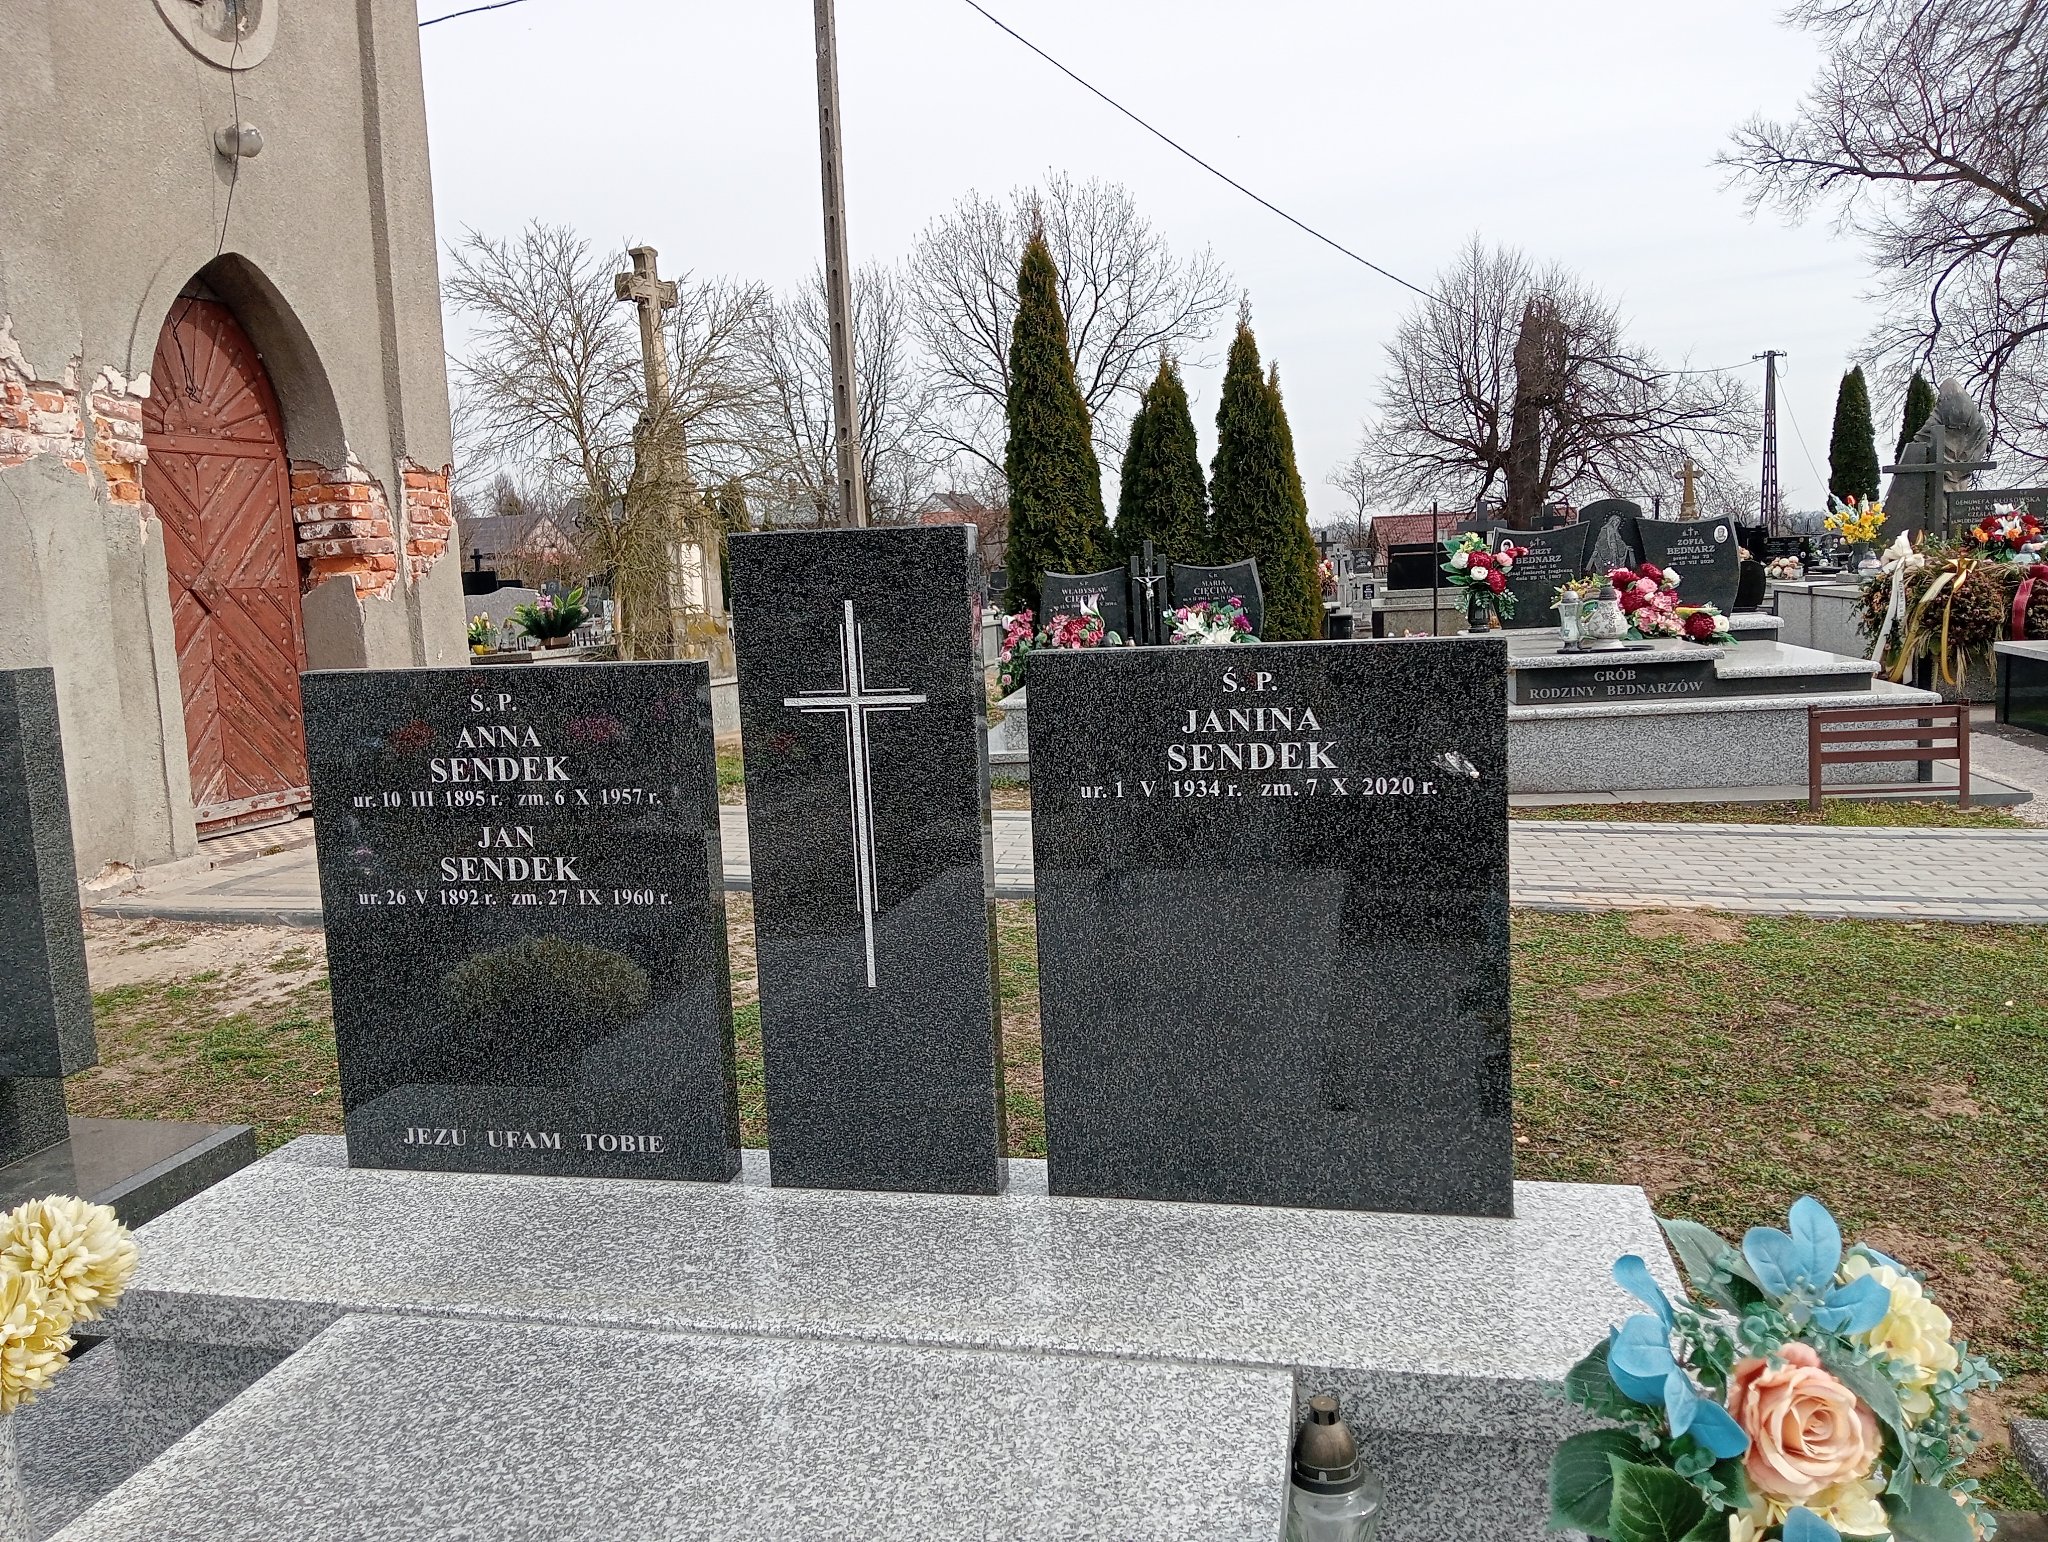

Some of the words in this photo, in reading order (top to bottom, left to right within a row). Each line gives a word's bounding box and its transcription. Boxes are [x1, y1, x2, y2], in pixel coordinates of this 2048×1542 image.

[1666, 545, 1716, 555] BEDNARZ
[1677, 538, 1705, 546] ZOFIA
[1515, 554, 1562, 565] BEDNARZ
[1061, 586, 1109, 595] WŁADYSŁAW
[1193, 586, 1234, 596] CIĘCIWA
[1222, 666, 1246, 693] Ś.
[1255, 671, 1278, 692] P.
[1594, 668, 1636, 682] GRÓB
[470, 688, 491, 712] Ś.
[498, 693, 517, 712] P.
[1529, 686, 1597, 699] RODZINY
[1607, 679, 1703, 696] BEDNARZÓW
[1181, 706, 1322, 734] JANINA
[456, 725, 542, 749] ANNA
[1167, 741, 1339, 772] SENDEK
[430, 756, 572, 783] SENDEK
[353, 796, 377, 808] ur.
[382, 791, 401, 807] 10
[411, 791, 434, 807] III
[446, 790, 486, 807] 1895
[491, 795, 503, 806] r.
[518, 793, 550, 806] zm.
[554, 788, 565, 806] 6
[574, 788, 590, 806] X
[600, 788, 642, 805] 1957
[648, 792, 661, 805] r.
[1080, 785, 1107, 799] ur.
[1115, 780, 1124, 798] 1
[1140, 780, 1157, 798] V
[1173, 779, 1220, 798] 1934
[1227, 783, 1242, 797] r.
[1260, 782, 1299, 797] zm.
[1306, 778, 1318, 796] 7
[1331, 777, 1349, 796] X
[1362, 776, 1415, 796] 2020
[1421, 781, 1438, 795] r.
[477, 825, 535, 849] JAN
[440, 856, 582, 882] SENDEK
[358, 893, 382, 905] ur.
[386, 889, 406, 905] 26
[415, 889, 429, 905] V
[440, 889, 479, 905] 1892
[485, 893, 497, 905] r.
[511, 892, 543, 905] zm.
[547, 889, 568, 905] 27
[578, 889, 602, 905] IX
[613, 888, 654, 905] 1960
[660, 893, 673, 905] r.
[403, 1127, 467, 1146] JEZU
[487, 1130, 561, 1149] UFAM
[581, 1133, 665, 1153] TOBIE
